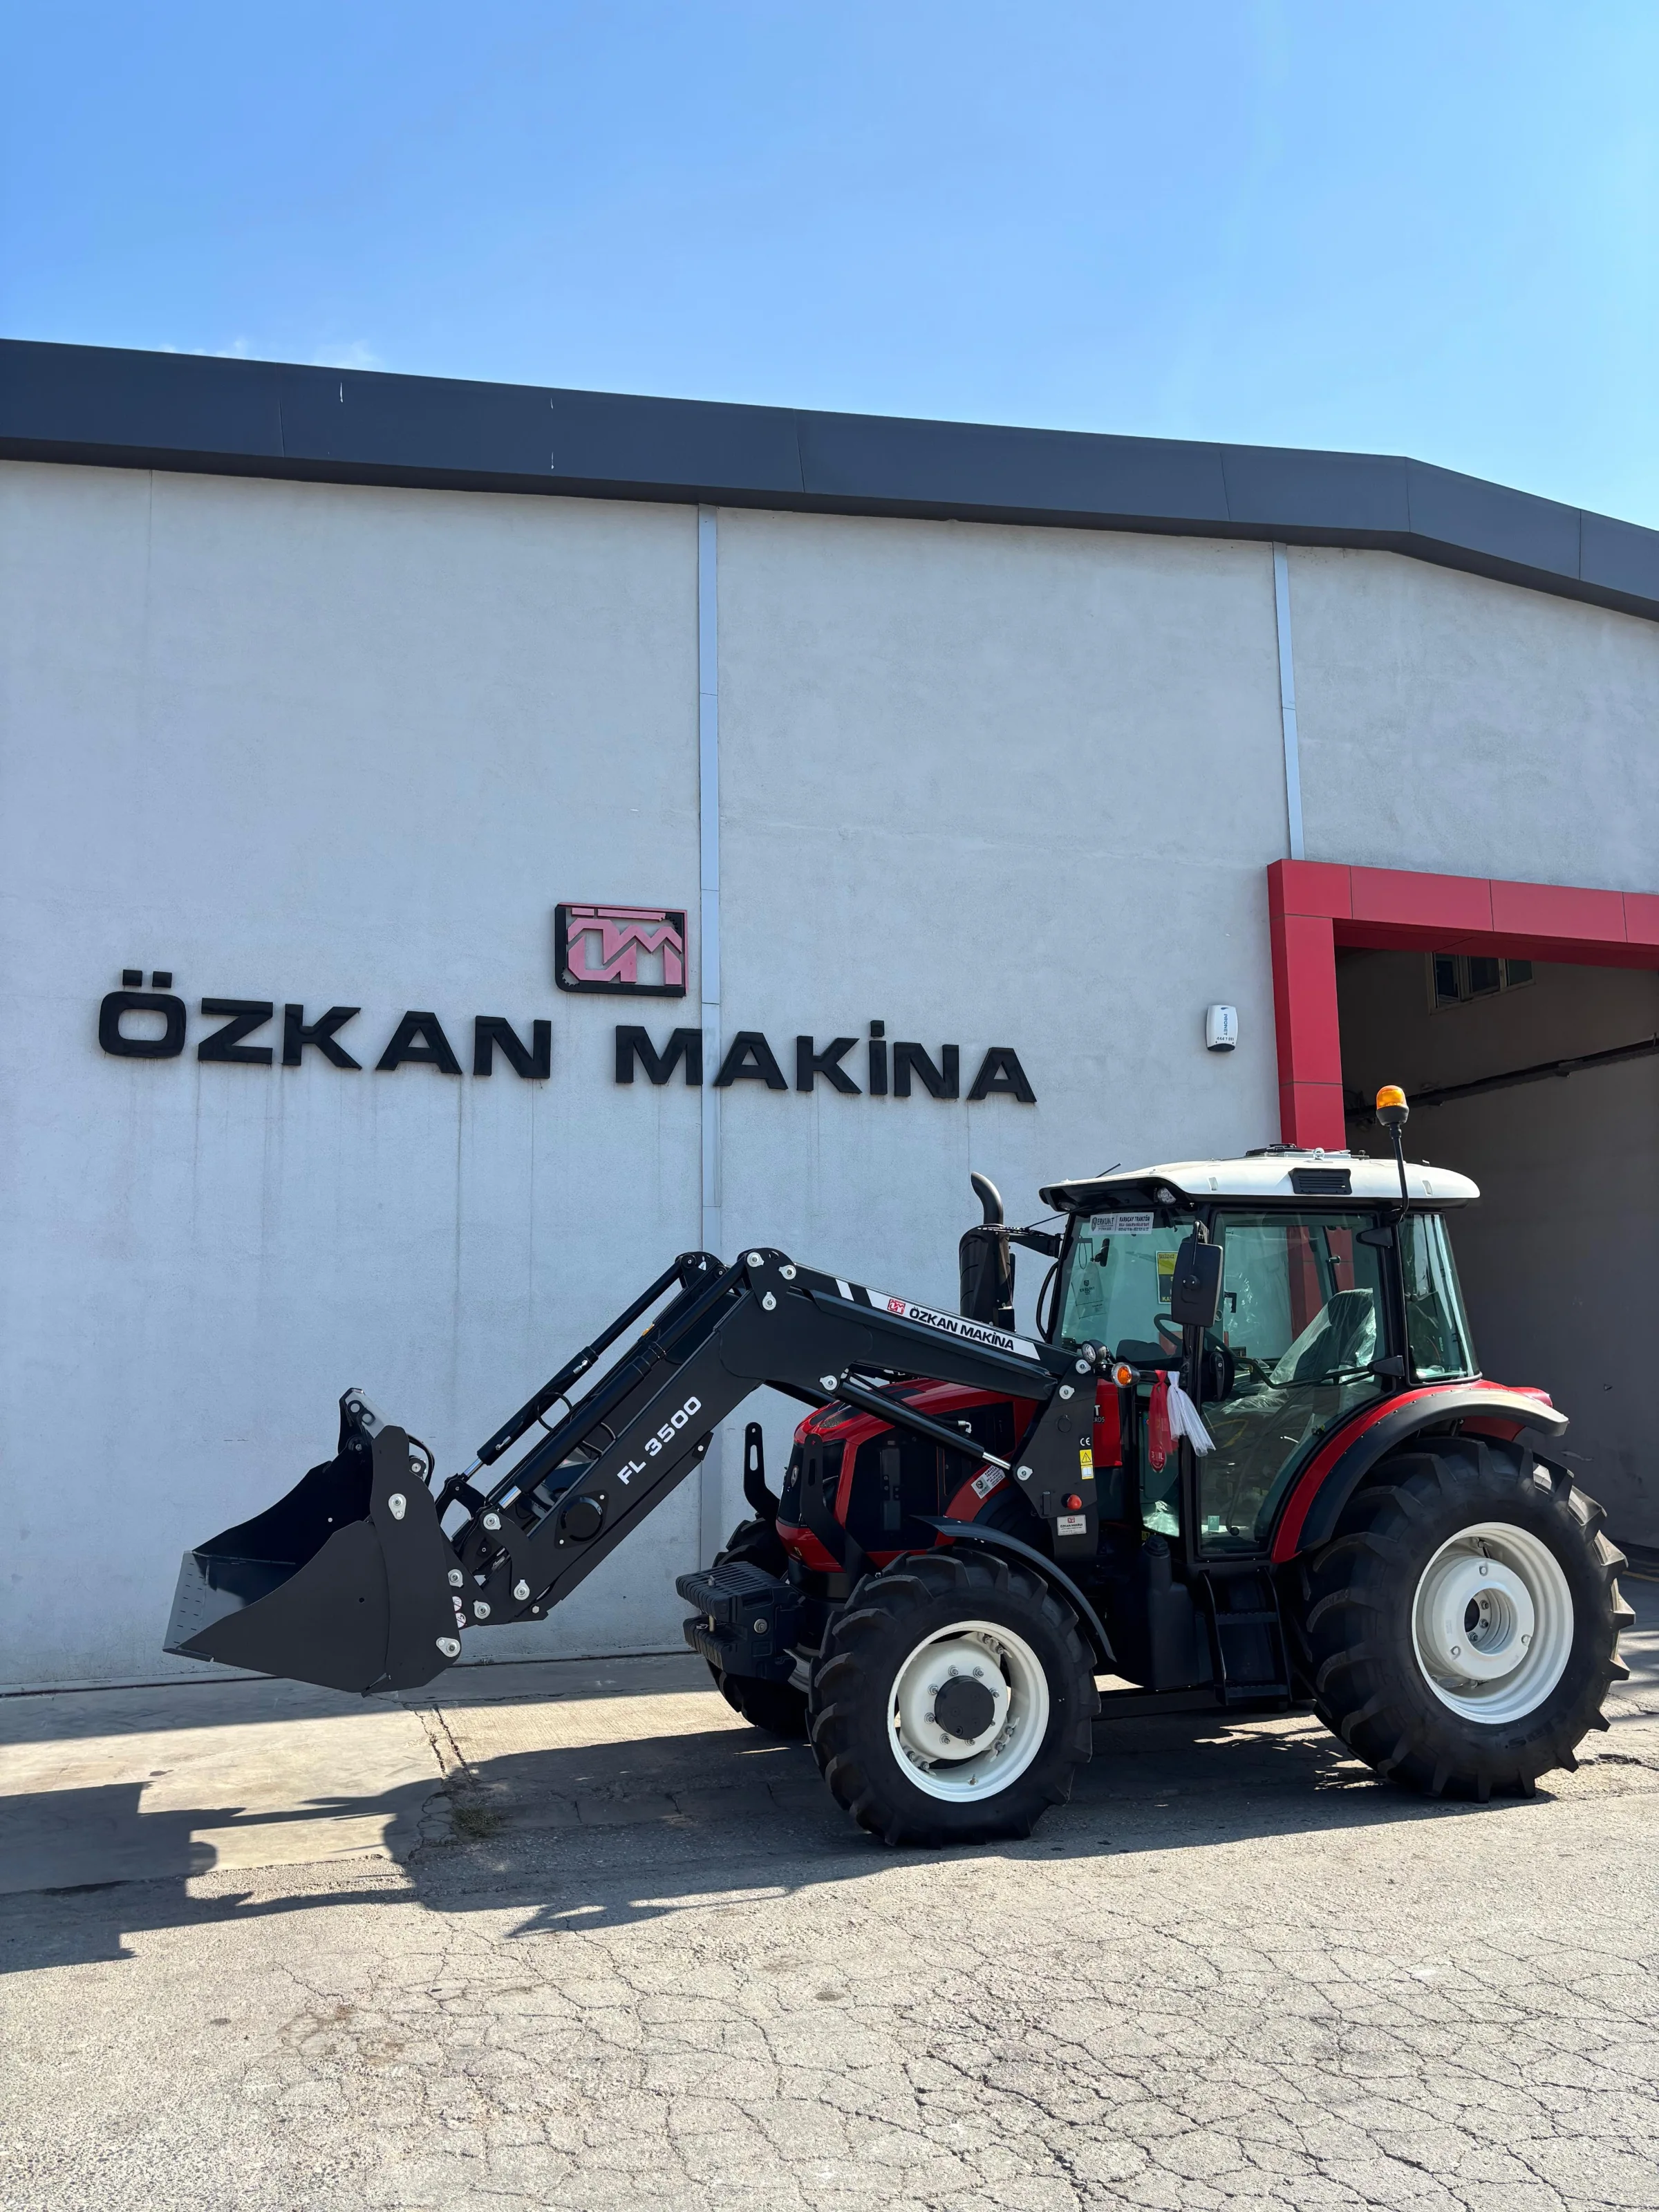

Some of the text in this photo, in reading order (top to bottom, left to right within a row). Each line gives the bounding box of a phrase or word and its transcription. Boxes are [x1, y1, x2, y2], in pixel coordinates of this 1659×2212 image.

[98, 969, 1038, 1103] ÖZKAN MAKİNA
[1097, 1217, 1115, 1226] ERKUNT
[909, 1306, 958, 1333] ÖZKAN
[960, 1324, 1014, 1351] MAKİNA
[617, 1396, 702, 1485] FL 3500
